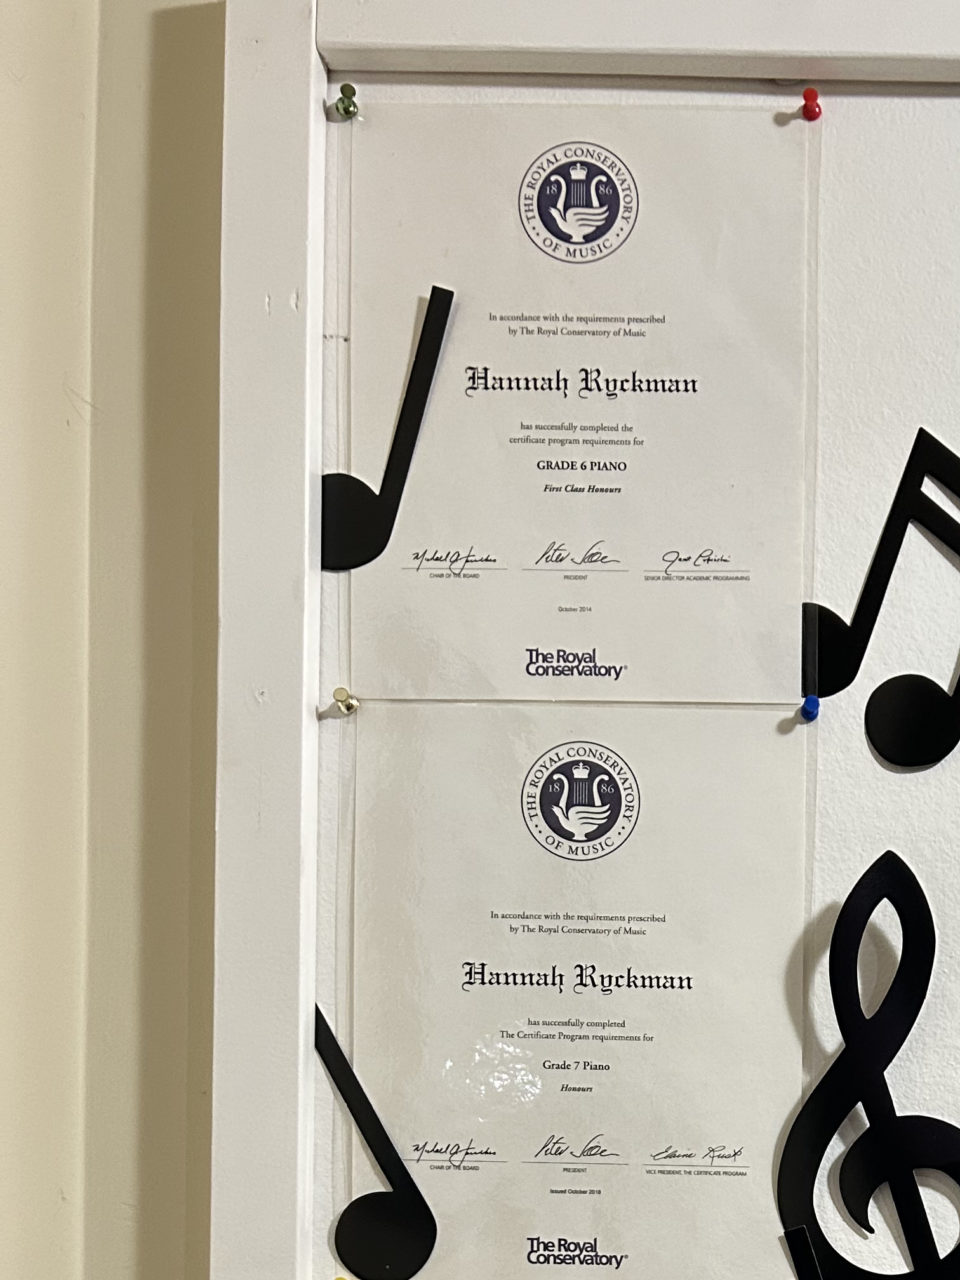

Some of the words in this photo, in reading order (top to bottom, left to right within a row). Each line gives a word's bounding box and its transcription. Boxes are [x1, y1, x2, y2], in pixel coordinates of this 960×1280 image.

[465, 365, 569, 399] Hannah
[578, 367, 698, 401] Ryckman
[536, 459, 578, 471] GRADE
[580, 460, 587, 472] 6
[589, 460, 627, 472] PIANO
[543, 483, 563, 493] First
[564, 483, 586, 494] Class
[586, 484, 622, 494] Honours
[525, 648, 554, 664] The
[557, 648, 597, 667] Royal
[525, 662, 623, 681] Conservatory
[461, 961, 565, 995] Hannah
[573, 963, 693, 996] Ryckman
[542, 1059, 572, 1071] Grade
[573, 1060, 581, 1071] 7
[583, 1060, 611, 1071] Piano
[559, 1083, 594, 1093] Honours
[527, 1236, 555, 1253] The
[558, 1237, 598, 1256] Royal
[527, 1250, 624, 1270] Conservatory
